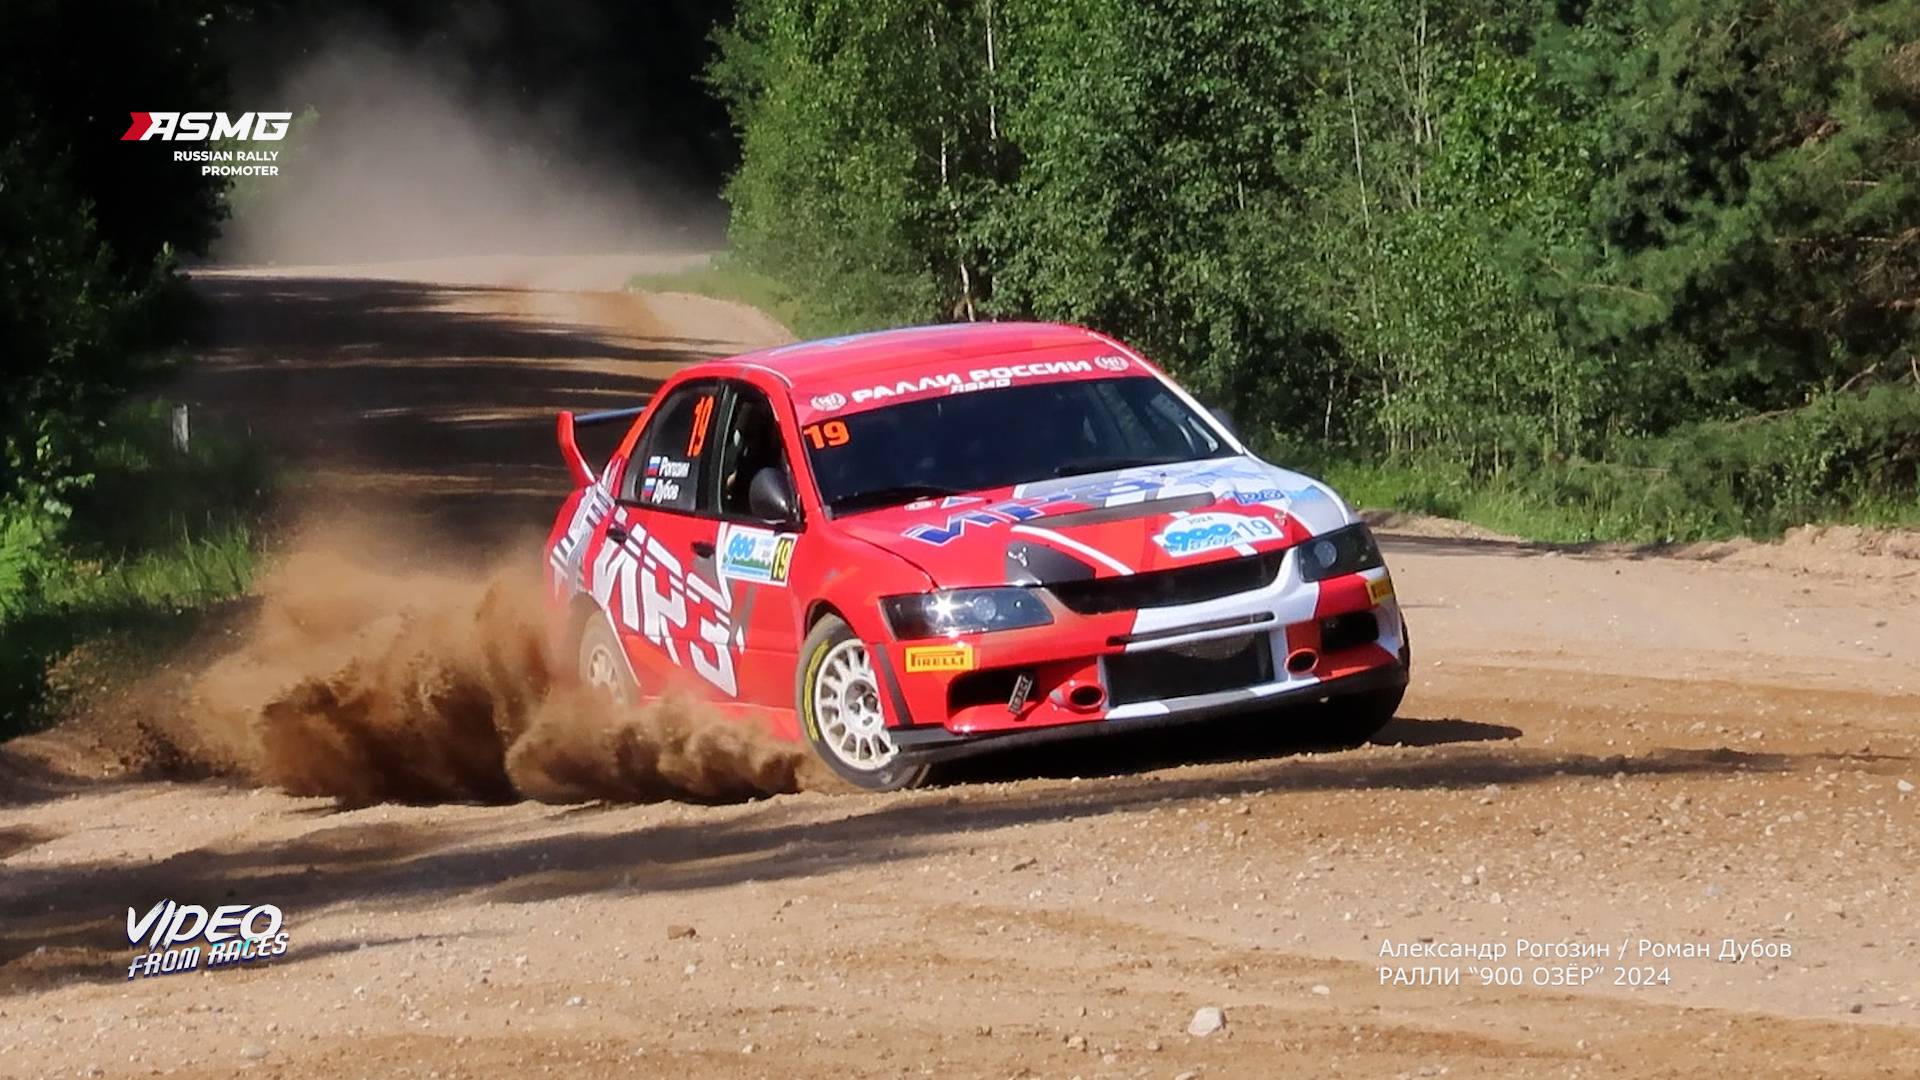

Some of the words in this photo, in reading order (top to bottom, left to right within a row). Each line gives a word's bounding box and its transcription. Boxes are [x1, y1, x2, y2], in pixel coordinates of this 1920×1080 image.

[851, 373, 961, 402] РАЛЛИ
[969, 360, 1092, 382] РОССИИ
[688, 395, 714, 457] 19
[803, 420, 850, 449] 19
[1165, 524, 1231, 551] 900
[1236, 519, 1273, 538] 19
[773, 539, 792, 580] 19
[910, 651, 965, 667] PIRELLI
